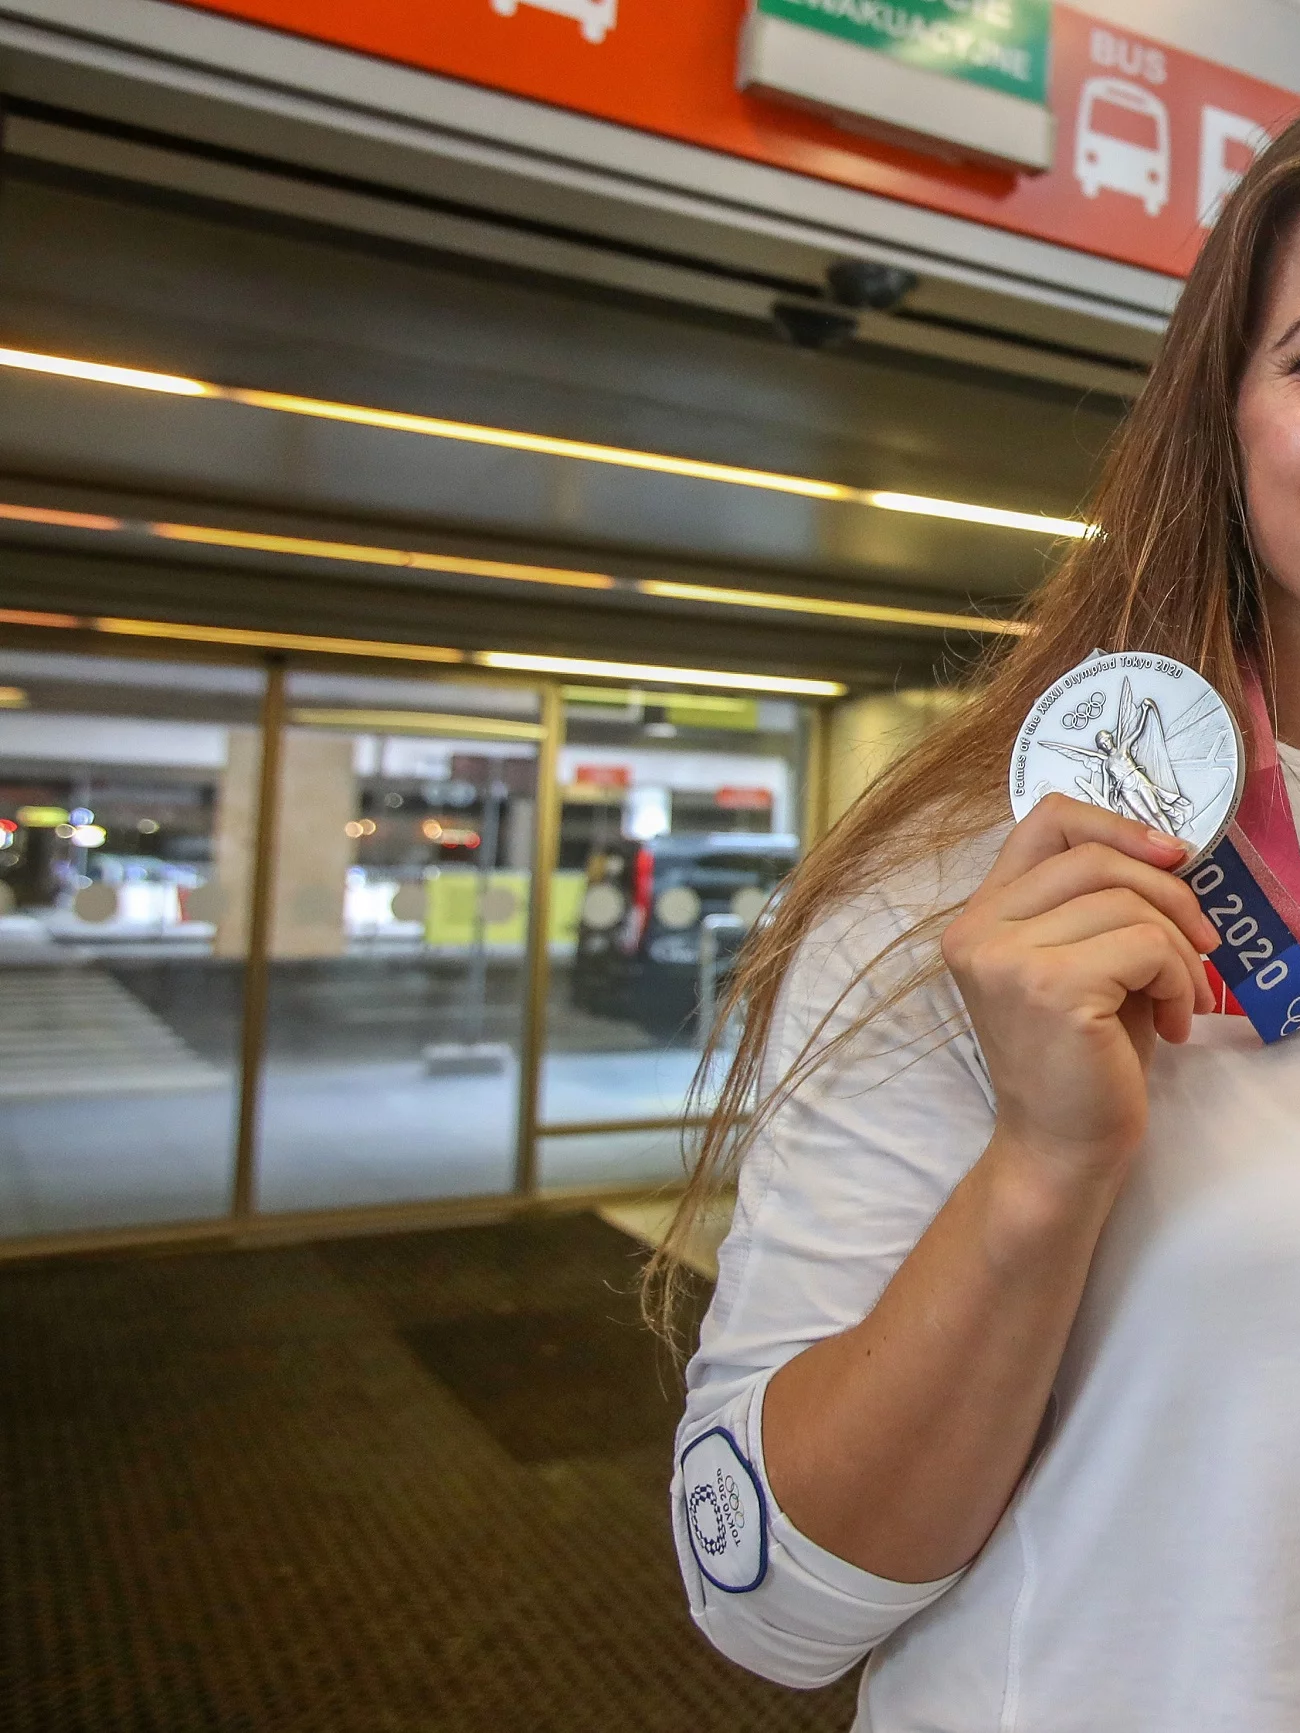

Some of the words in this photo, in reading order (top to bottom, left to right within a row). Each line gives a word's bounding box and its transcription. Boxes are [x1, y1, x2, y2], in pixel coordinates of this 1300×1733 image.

[1090, 29, 1167, 84] BUS
[1063, 658, 1117, 689] Olympiad
[1120, 656, 1152, 670] Tokyo
[1154, 660, 1184, 679] 2020
[1037, 685, 1064, 715] XXXII
[1024, 715, 1041, 736] the
[1020, 737, 1031, 751] of
[1014, 755, 1026, 796] Games
[1207, 893, 1289, 991] 2020
[717, 1468, 727, 1501] 2020
[723, 1503, 741, 1547] TOKYO
